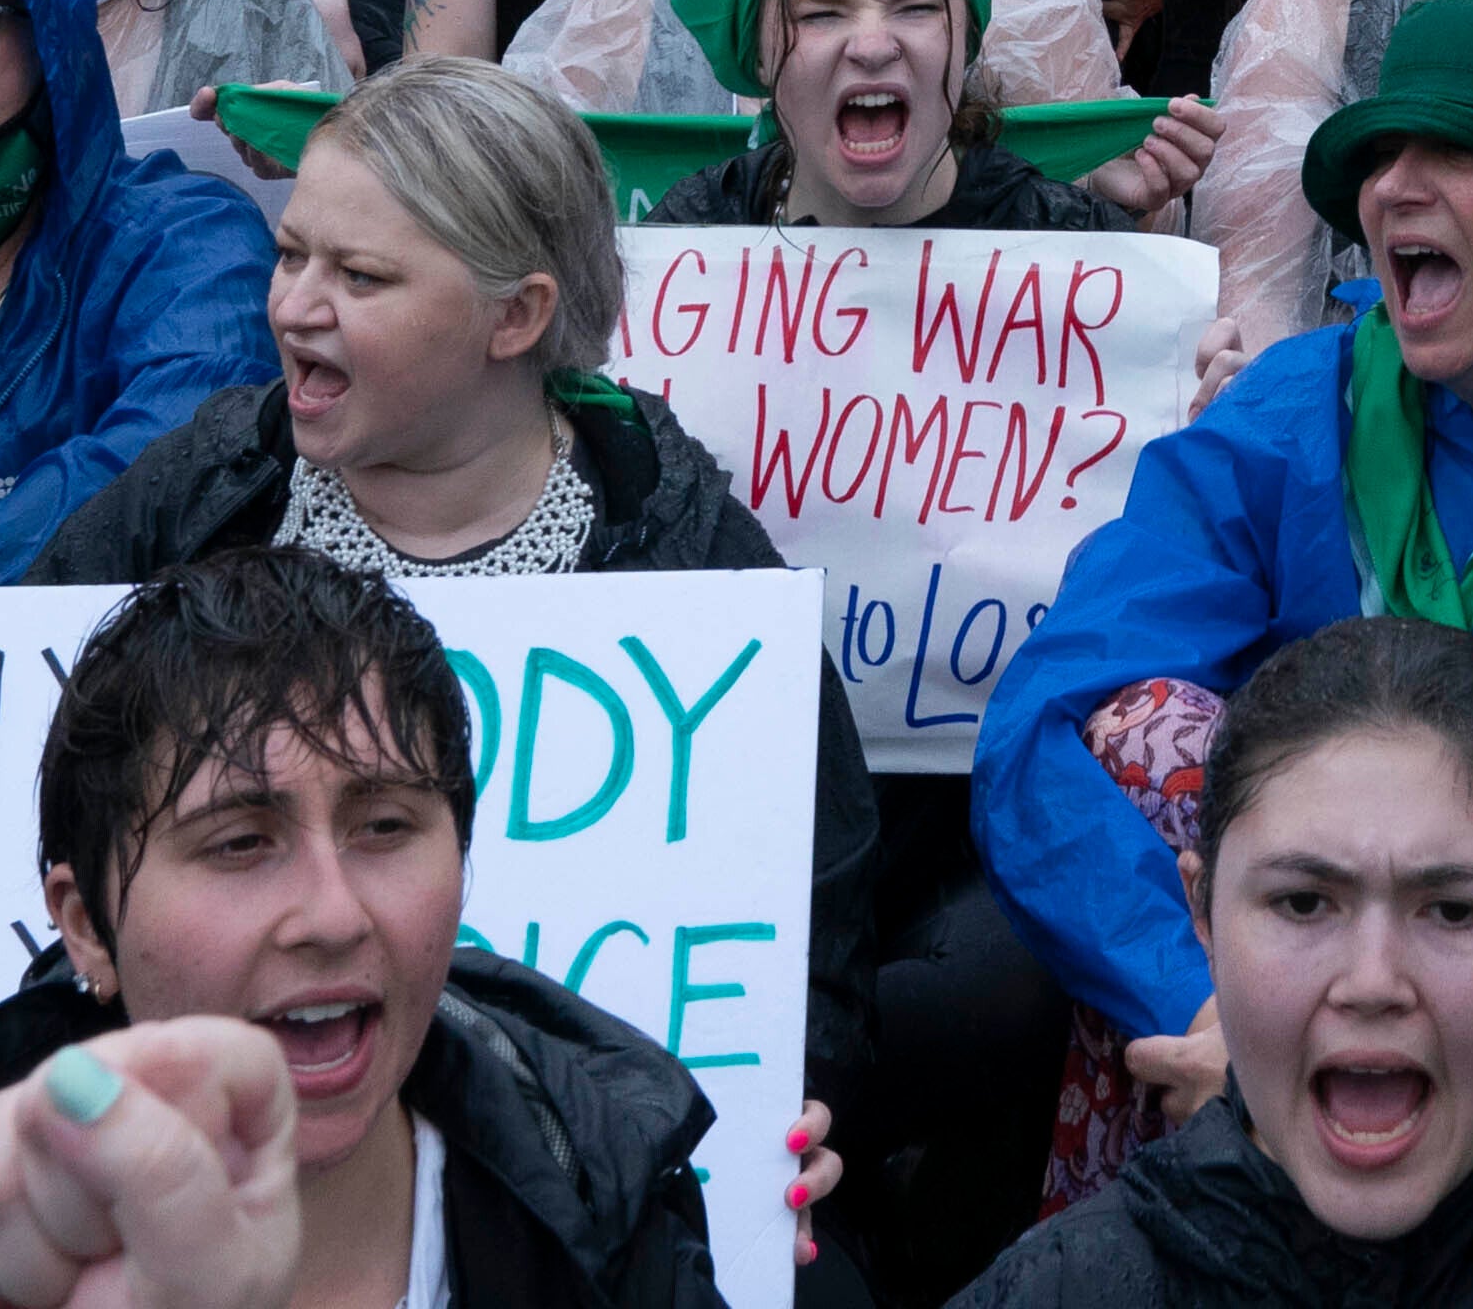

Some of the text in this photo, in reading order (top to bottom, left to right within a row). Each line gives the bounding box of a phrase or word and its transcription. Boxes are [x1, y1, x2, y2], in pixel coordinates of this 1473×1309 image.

[618, 238, 1125, 407] GING WAR
[750, 383, 1127, 525] WOMEN?
